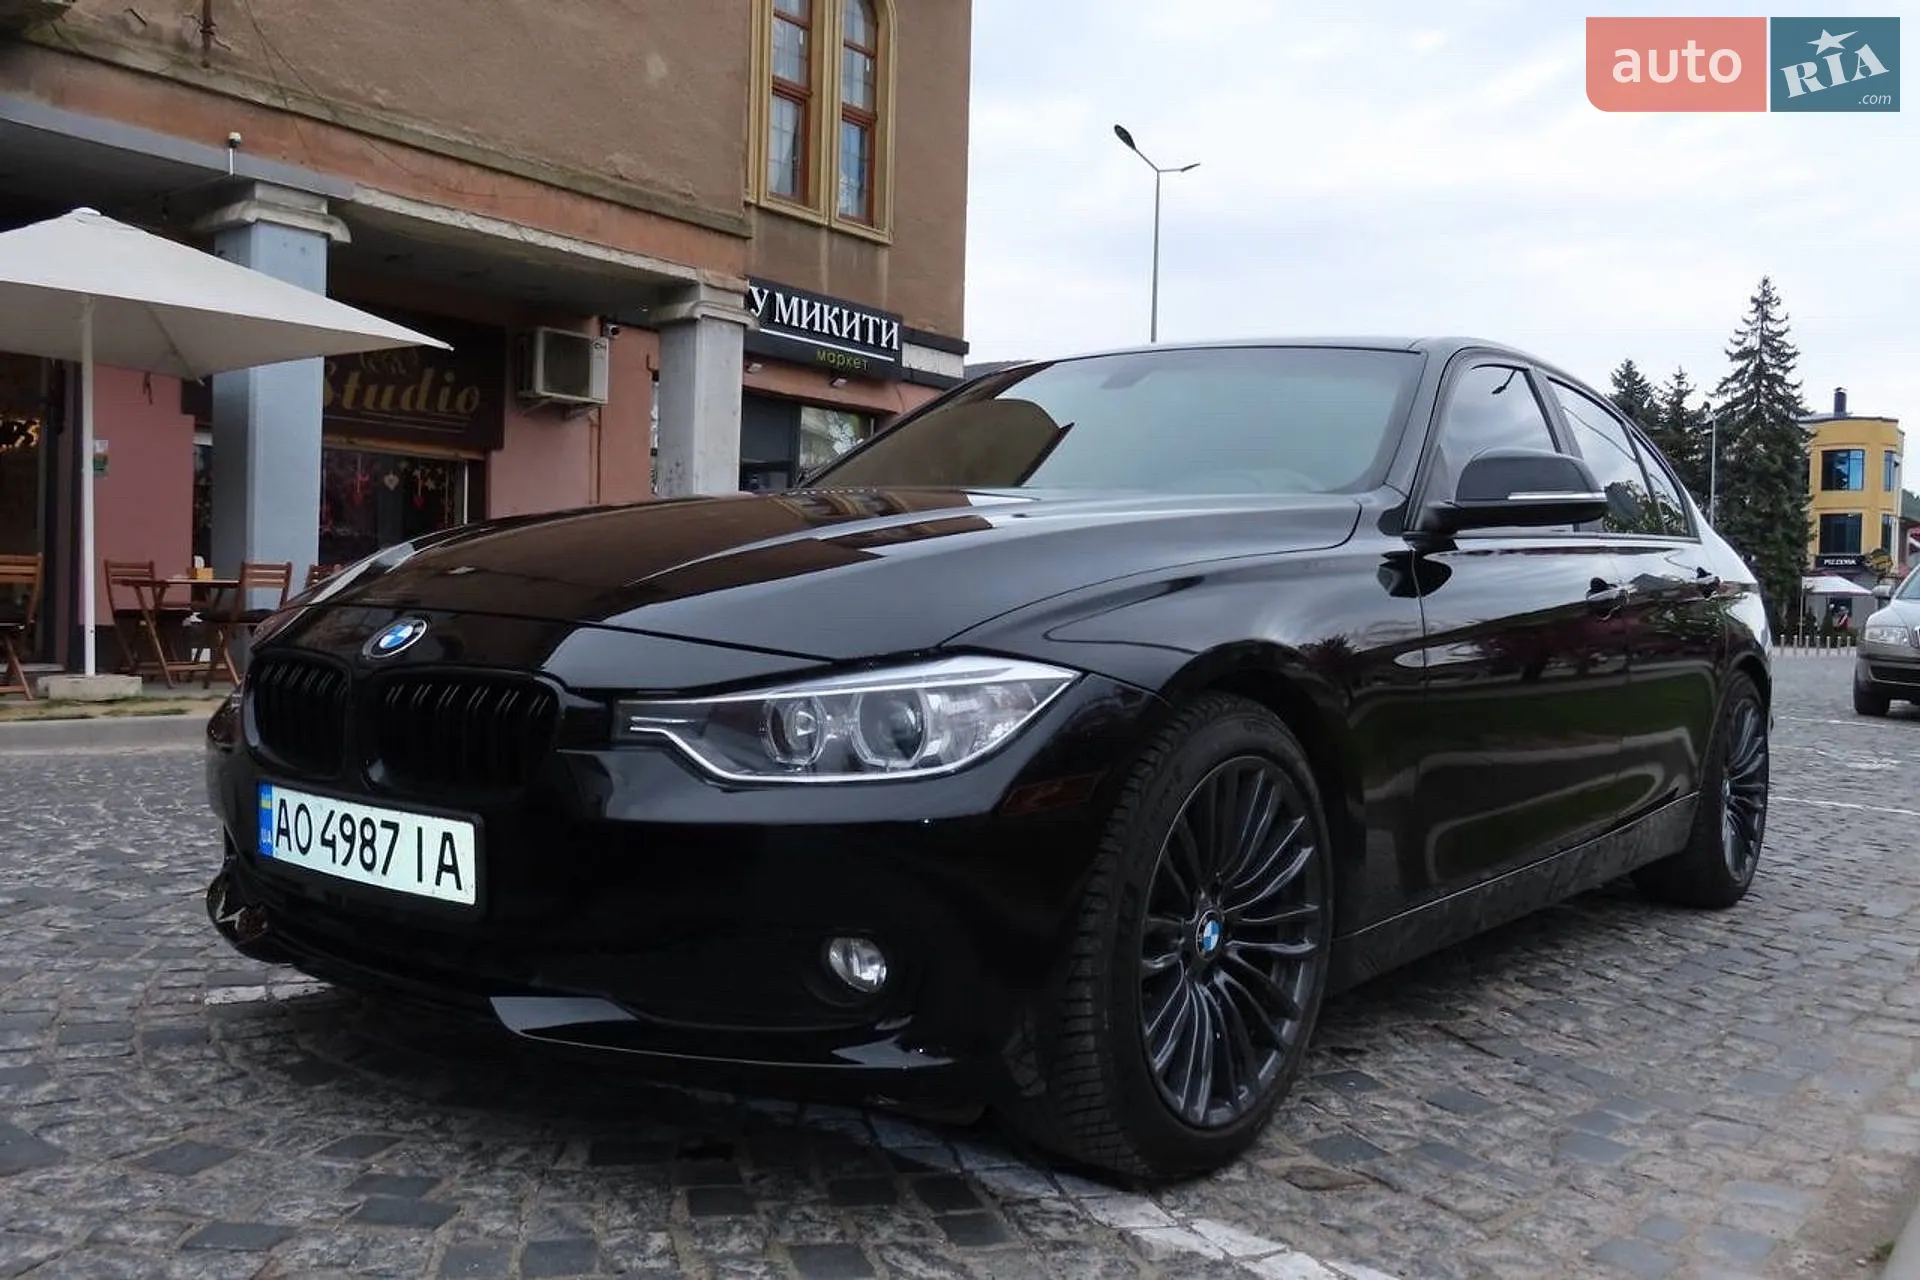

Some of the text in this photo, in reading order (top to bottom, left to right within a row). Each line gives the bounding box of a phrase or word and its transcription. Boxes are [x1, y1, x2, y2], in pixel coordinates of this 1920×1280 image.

[749, 286, 900, 350] У МИКИТИ
[816, 350, 869, 371] маркет
[275, 798, 463, 891] AO 4987 IA
